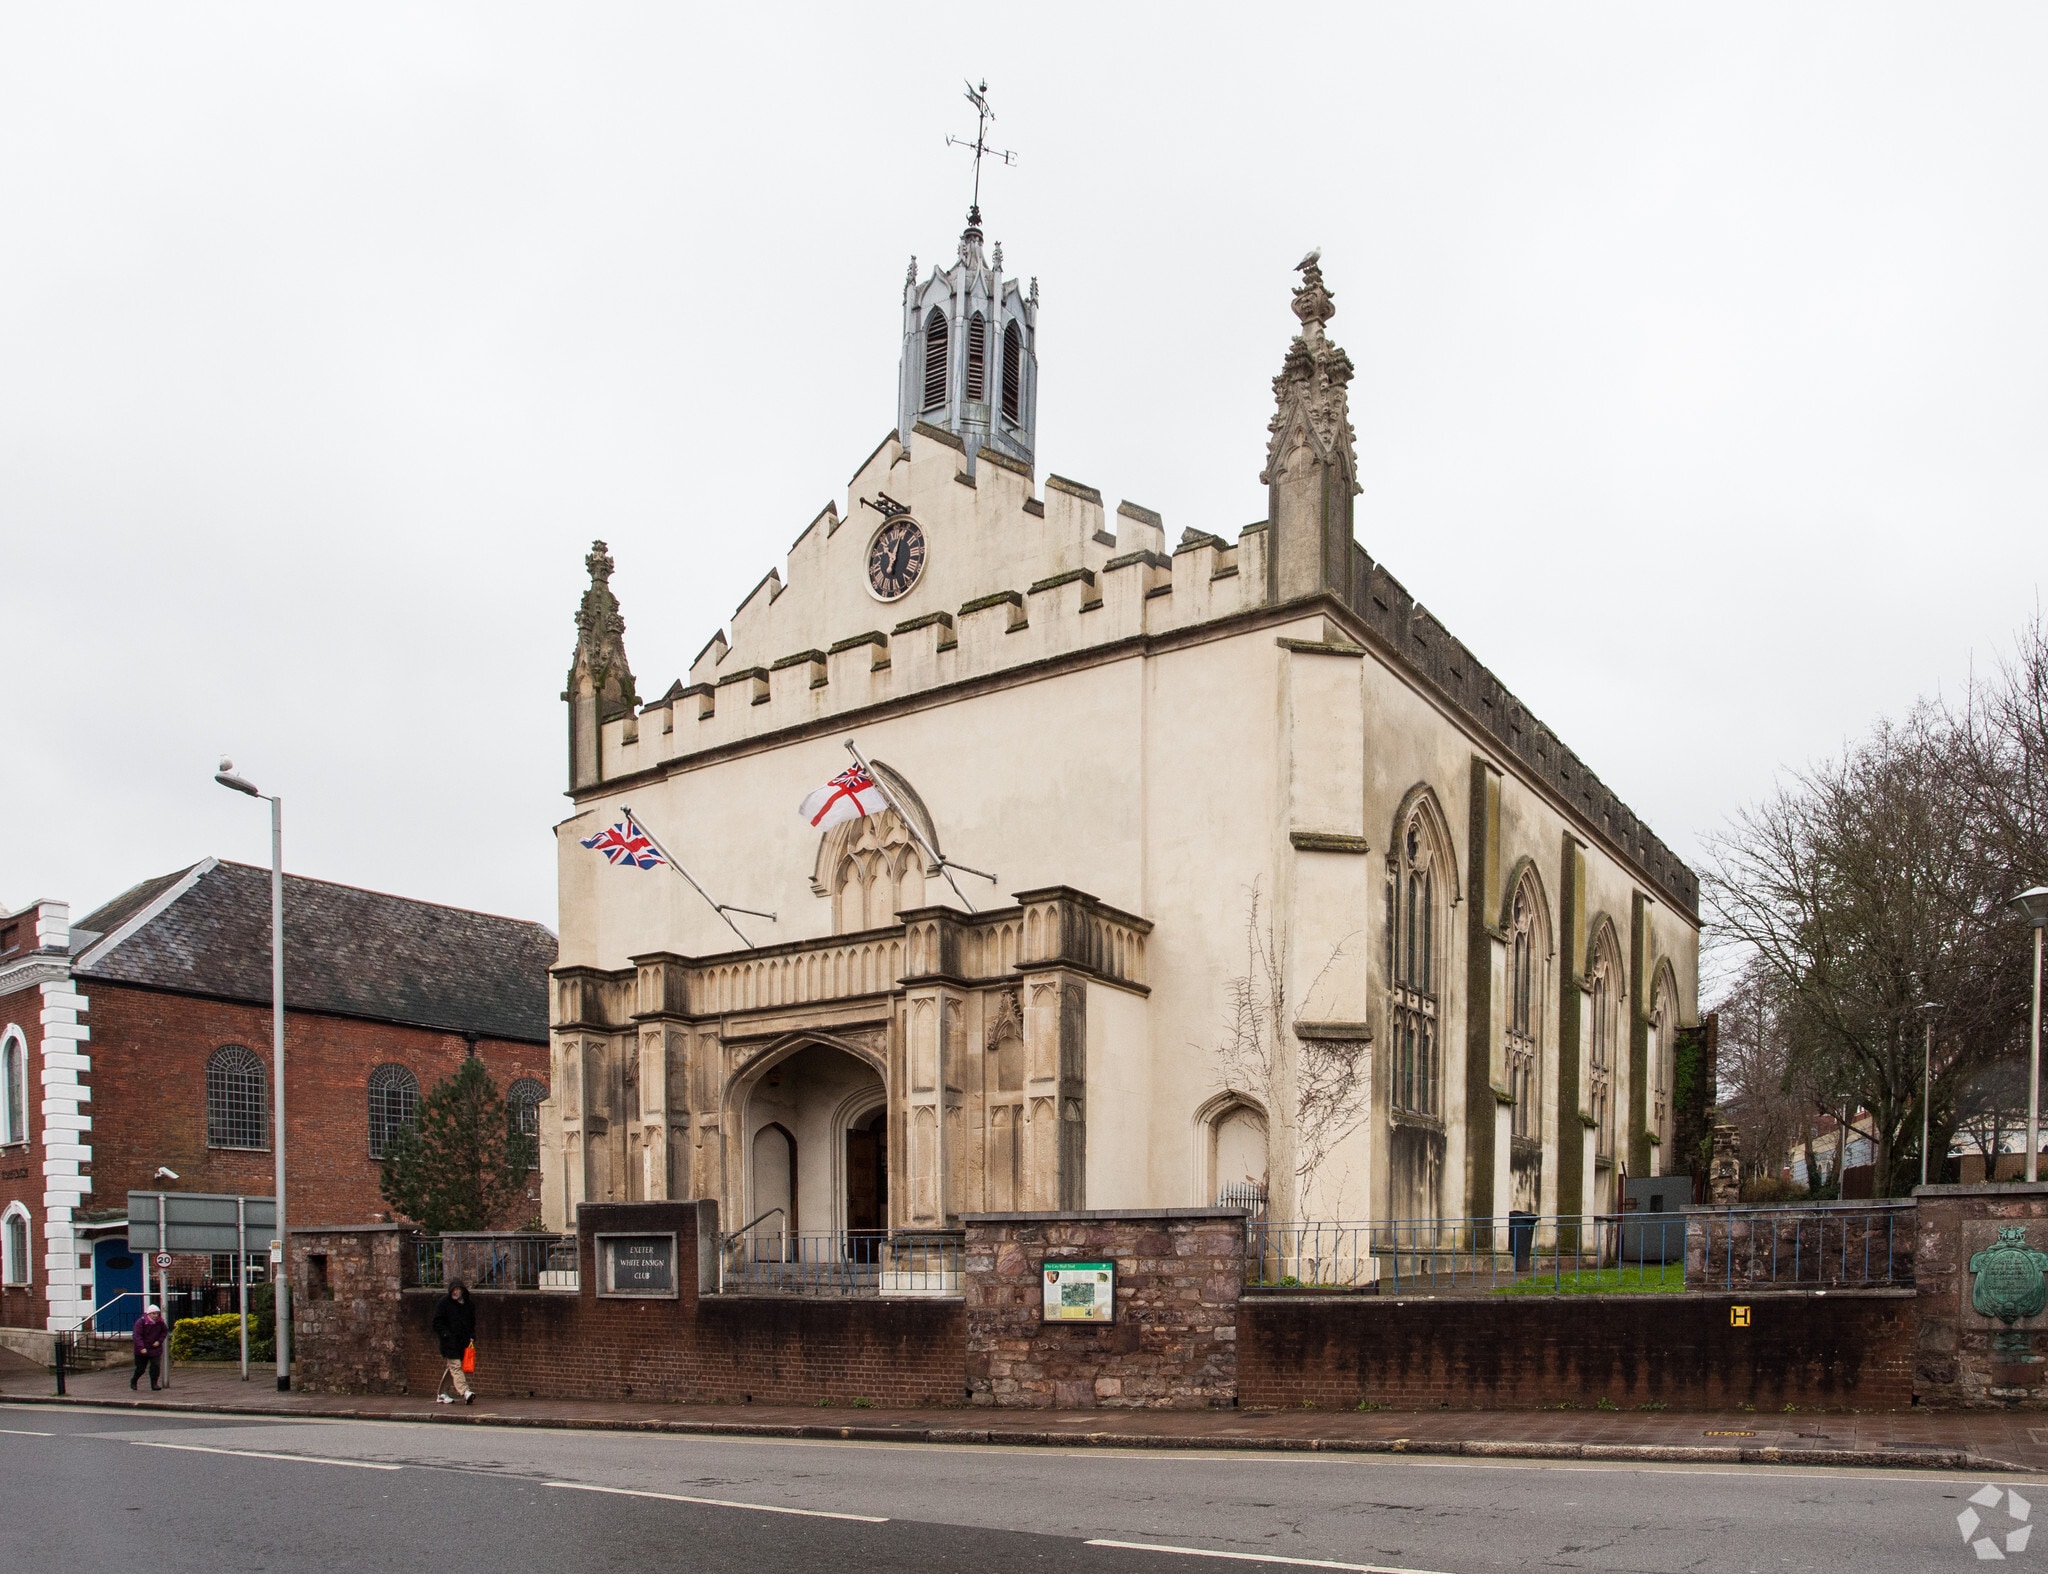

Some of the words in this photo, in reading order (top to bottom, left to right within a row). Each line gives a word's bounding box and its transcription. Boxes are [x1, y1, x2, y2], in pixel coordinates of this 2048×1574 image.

[1005, 150, 1018, 167] E
[910, 547, 919, 556] III
[906, 559, 918, 573] IIII
[629, 1246, 654, 1254] EXETER
[157, 1256, 171, 1264] 20
[620, 1259, 639, 1267] WHITE
[641, 1259, 664, 1267] ENSIGN
[634, 1272, 650, 1280] CLUB
[1733, 1308, 1748, 1325] H
